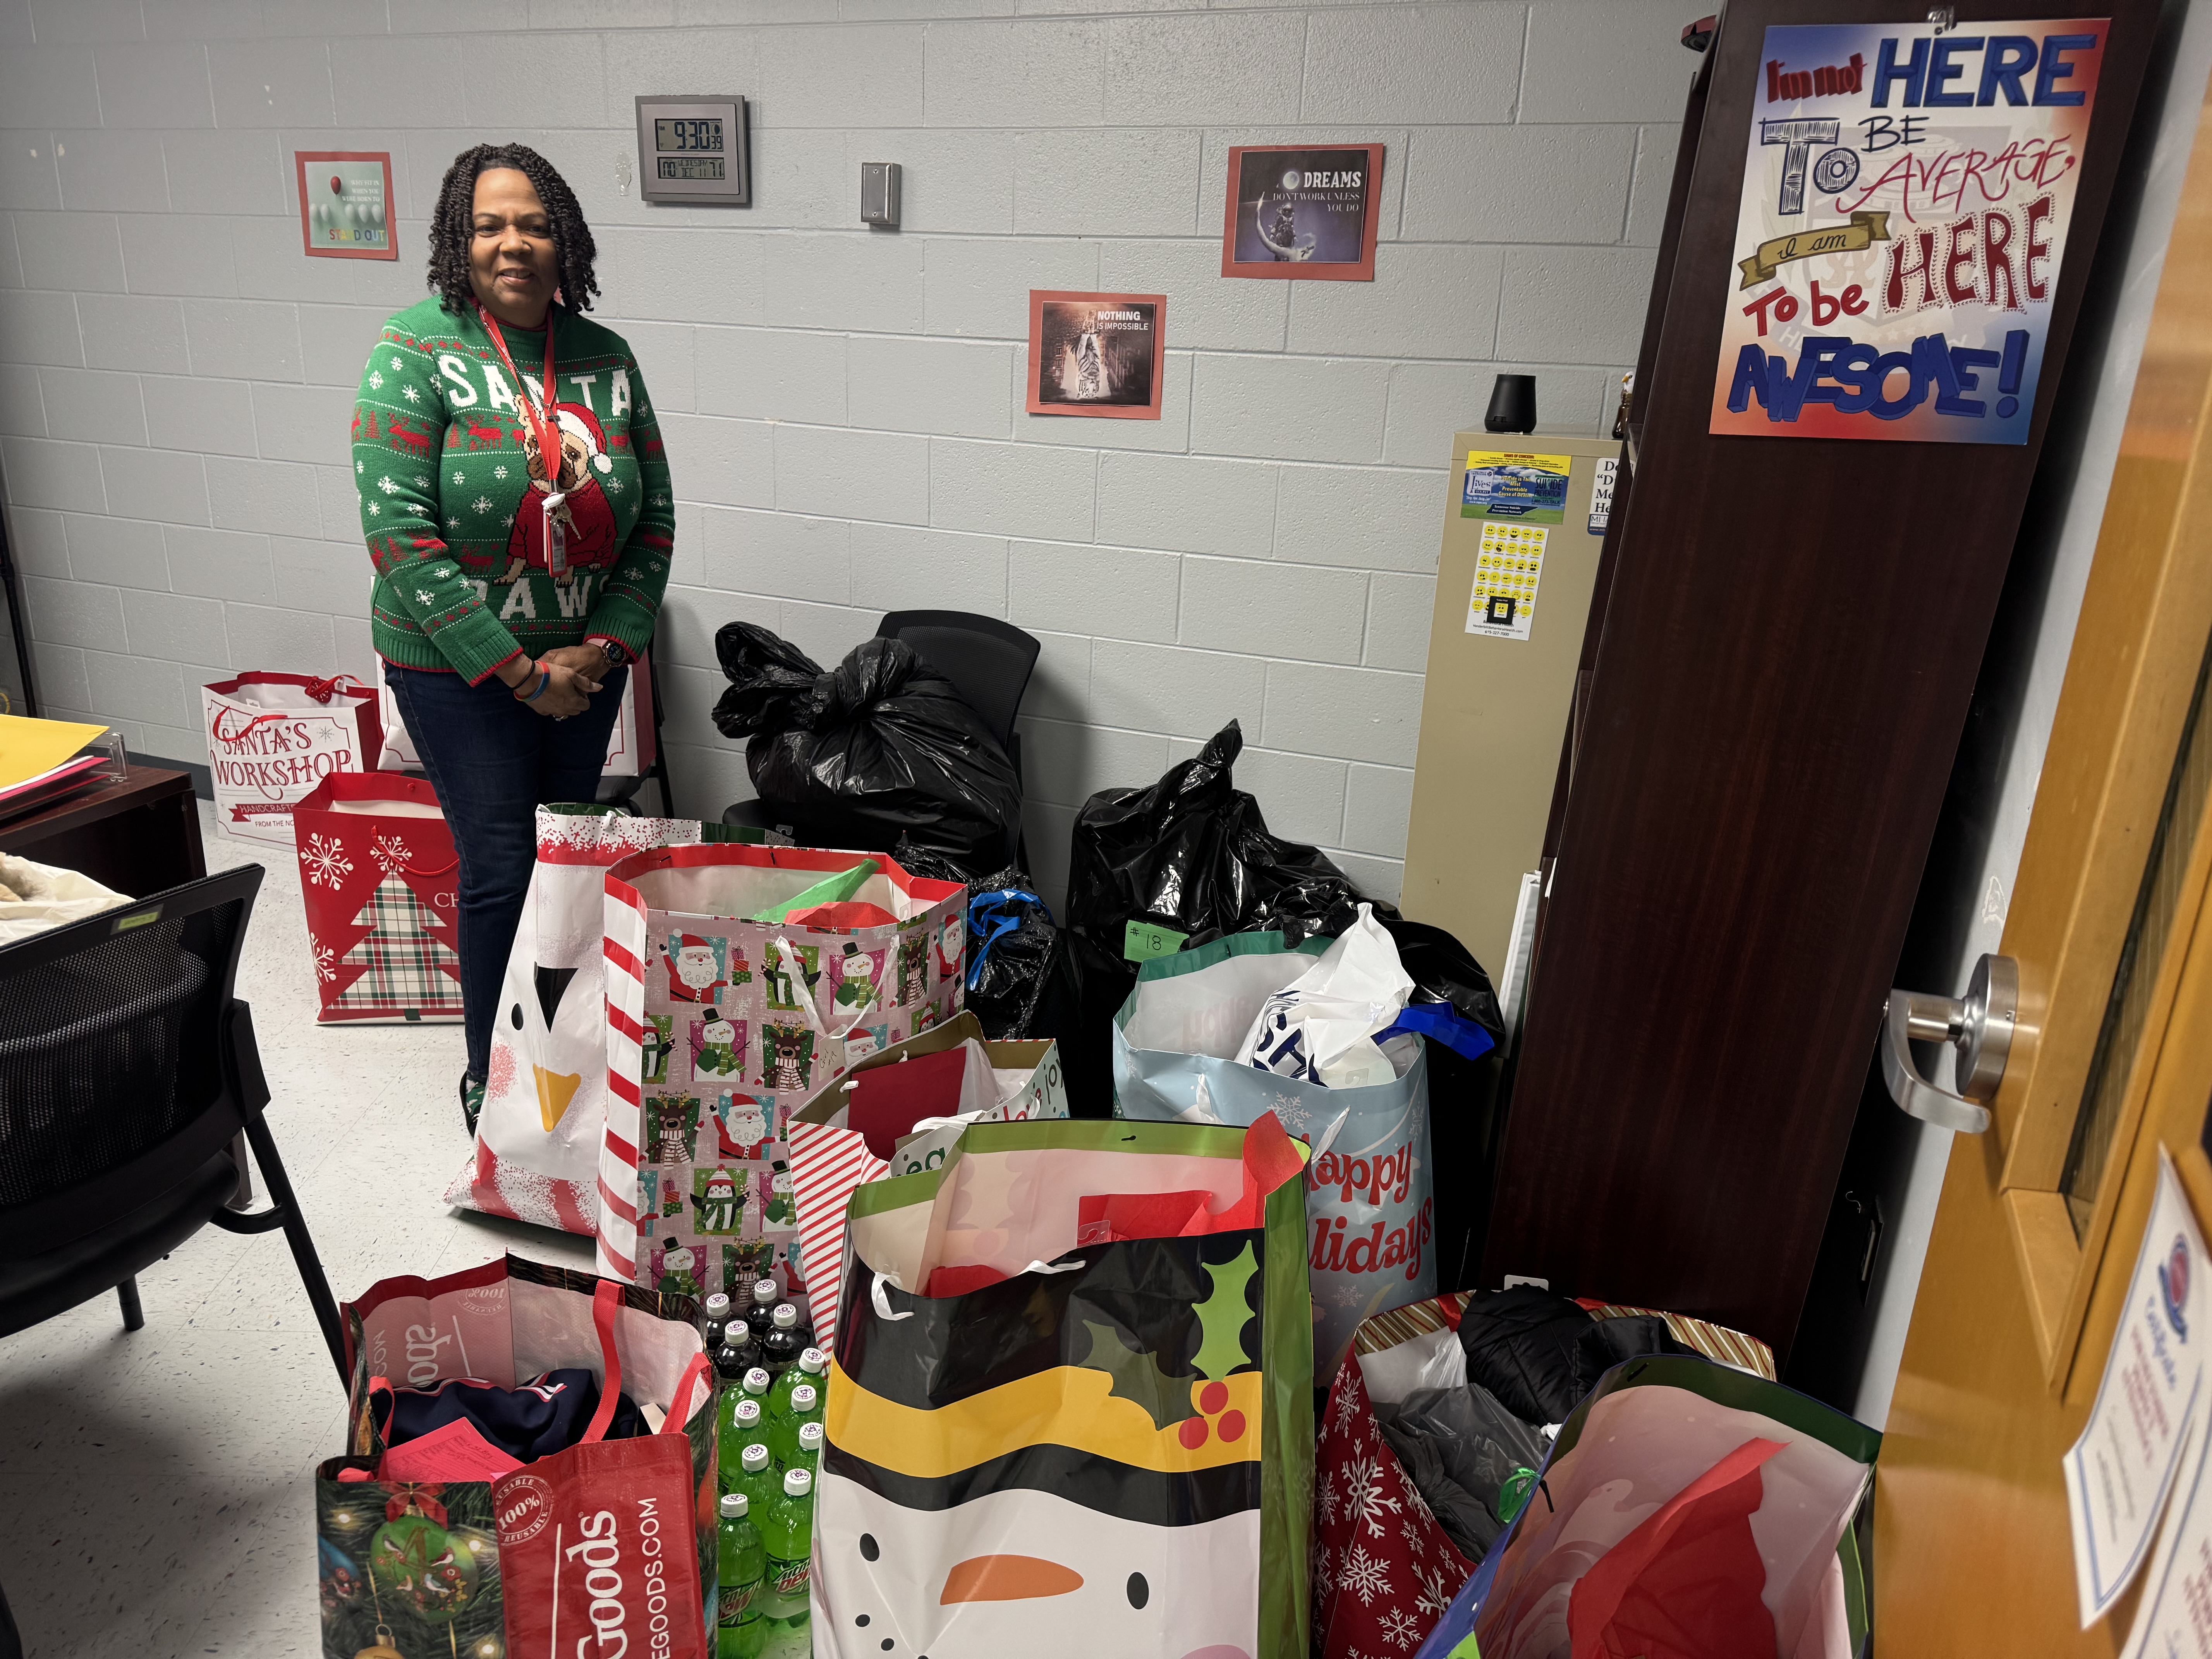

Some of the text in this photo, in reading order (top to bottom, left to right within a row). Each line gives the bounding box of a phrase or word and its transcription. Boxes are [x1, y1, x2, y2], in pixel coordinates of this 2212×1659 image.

[1812, 53, 1868, 98] not
[1870, 34, 2097, 108] HERE
[674, 121, 710, 149] 9:30
[1858, 115, 1930, 153] BE
[681, 167, 694, 177] DEC
[1304, 171, 1362, 189] DREAMS
[1299, 192, 1326, 201] WORK
[1328, 192, 1360, 201] UNLESS
[1327, 203, 1359, 212] YOU DO
[364, 229, 385, 241] OUT
[1813, 233, 1847, 251] am
[1883, 192, 2057, 314] HERE
[1097, 311, 1140, 321] NOTHING
[1743, 280, 1870, 337] To be
[1104, 323, 1149, 331] IMPOSSIBLE
[1726, 329, 2030, 422] AWESOME!
[222, 716, 312, 755] SANTA'S
[210, 749, 352, 800] WORKSHOP
[498, 1494, 540, 1530] 100%
[504, 1511, 549, 1543] REUSABLE
